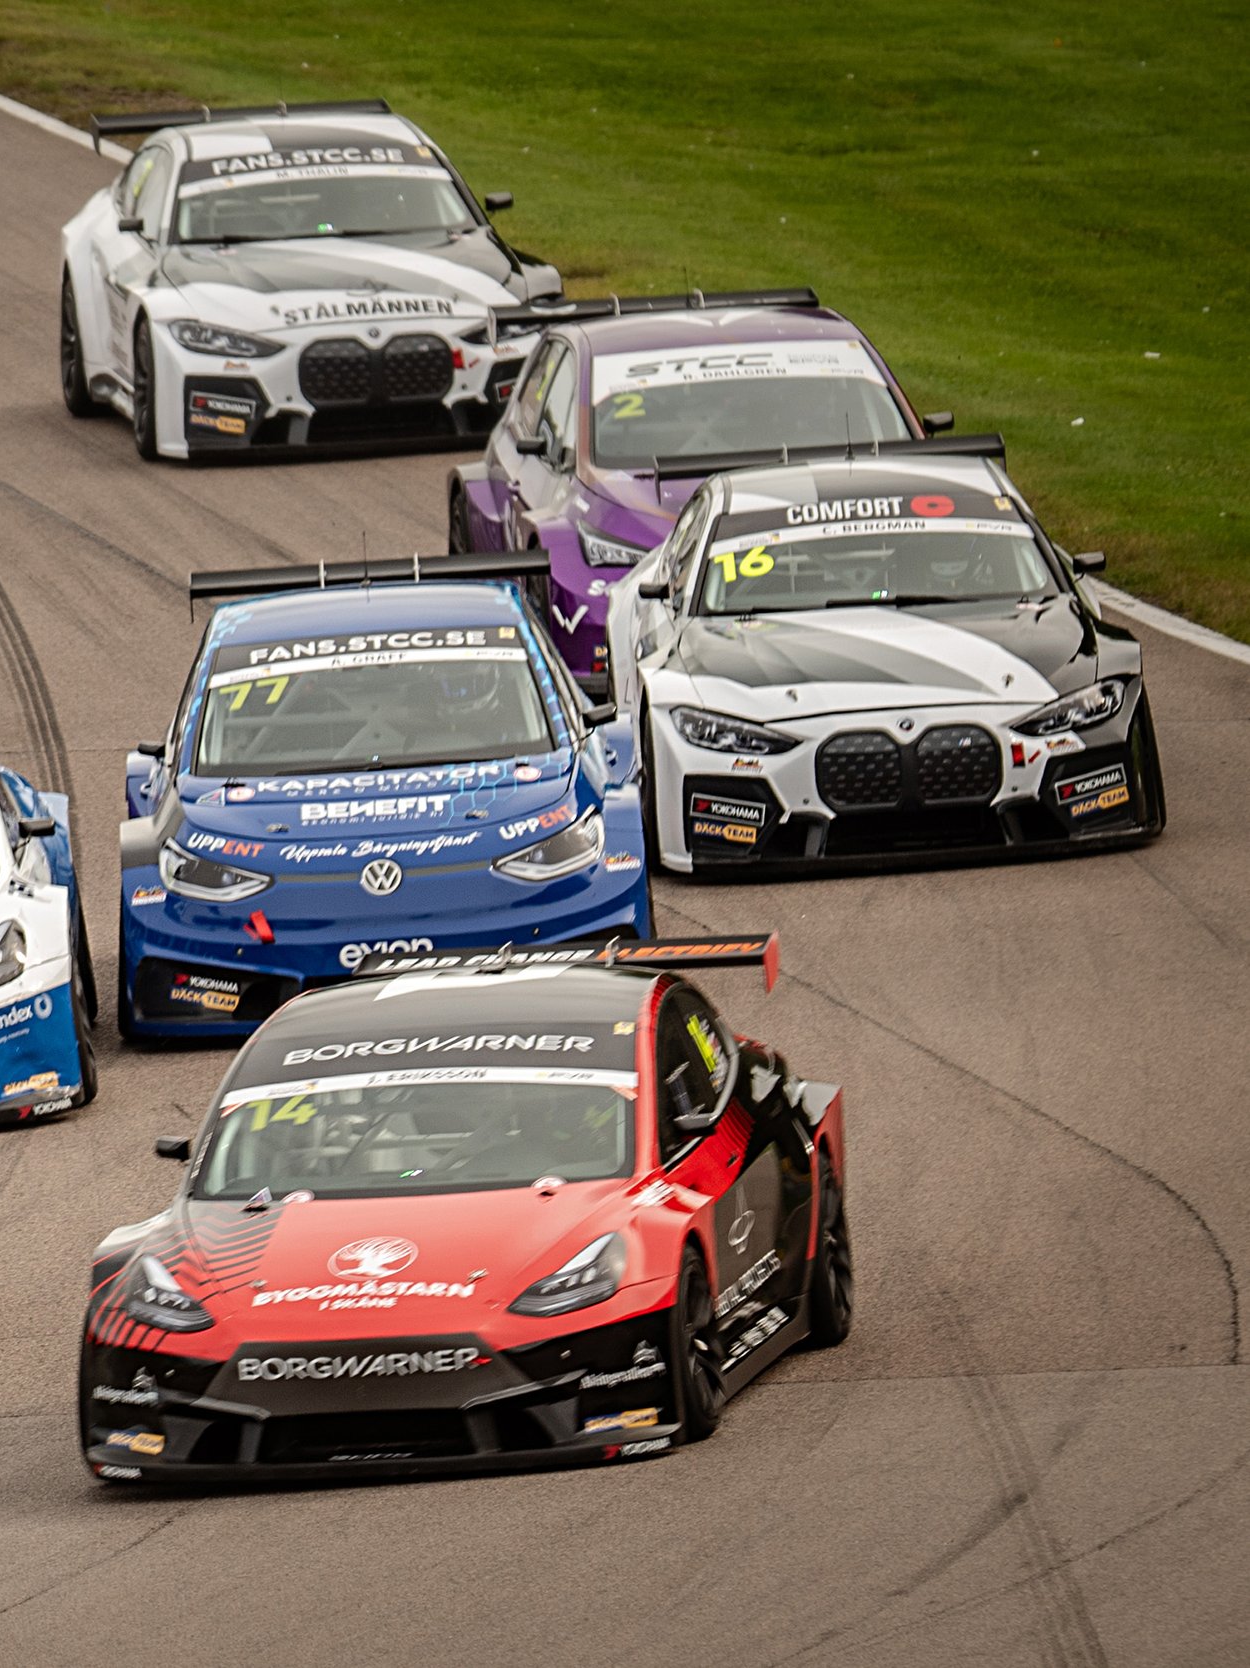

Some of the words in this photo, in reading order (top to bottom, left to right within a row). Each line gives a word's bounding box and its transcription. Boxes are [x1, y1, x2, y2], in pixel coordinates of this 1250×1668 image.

[211, 147, 405, 176] FANS.STCC.SE
[284, 295, 453, 325] STÅLMÄNNEN
[626, 353, 774, 378] STCC
[613, 393, 646, 419] 2
[786, 496, 904, 524] COMFORT
[843, 520, 927, 533] BERGMAN
[713, 546, 775, 583] 16
[249, 630, 487, 666] FANS.STCC.SE
[219, 676, 290, 711] 77
[257, 765, 502, 793] KAPACITATOR
[1074, 770, 1122, 794] YOKOHAMA
[301, 794, 451, 820] BENEFIT
[711, 802, 760, 820] YOKOHAMA
[187, 832, 265, 857] UPPENT
[375, 955, 462, 971] LEAD
[282, 1034, 596, 1067] BORGWARNER
[246, 1093, 318, 1132] 14
[238, 1346, 482, 1383] BORGWARNER
